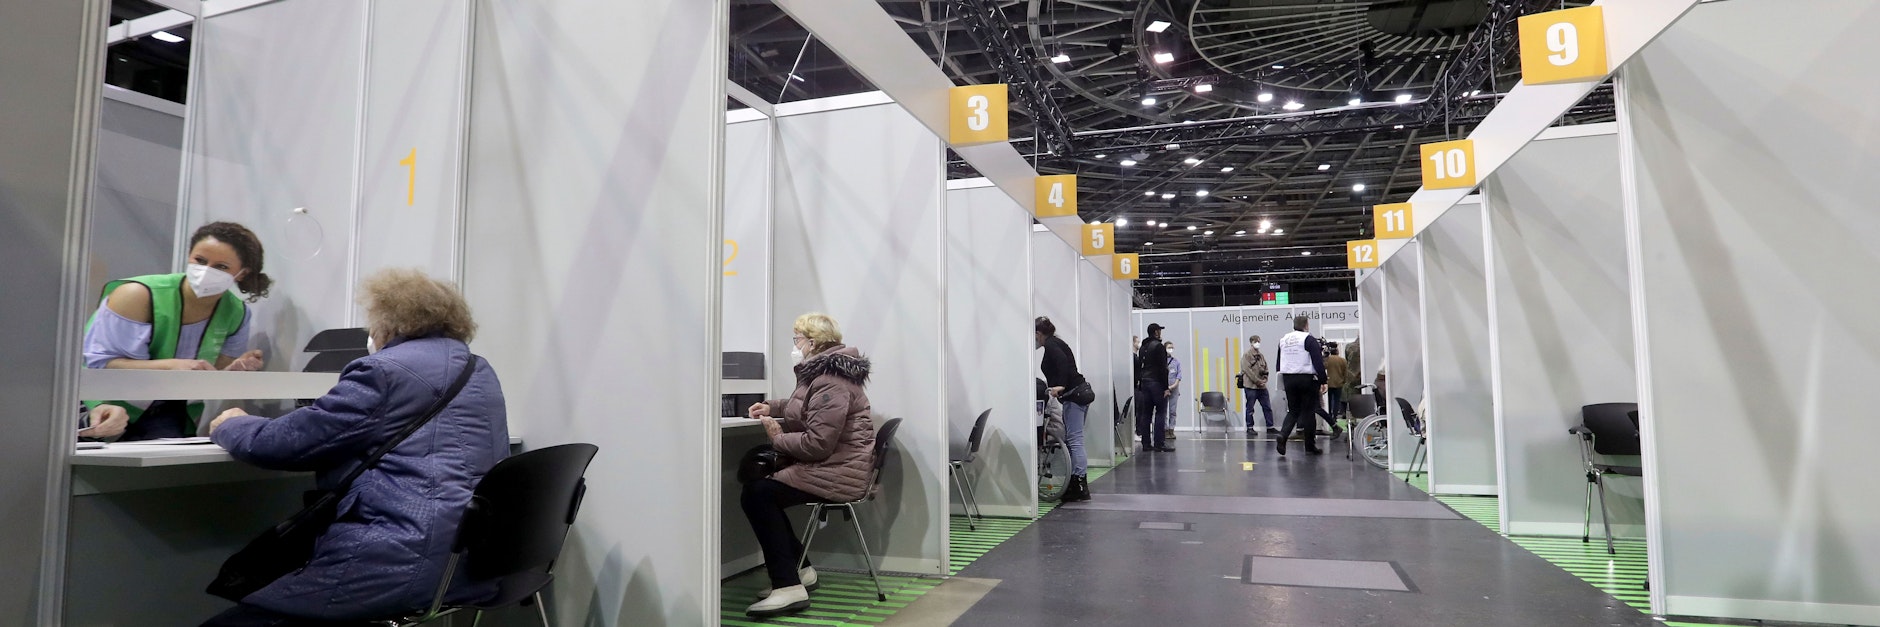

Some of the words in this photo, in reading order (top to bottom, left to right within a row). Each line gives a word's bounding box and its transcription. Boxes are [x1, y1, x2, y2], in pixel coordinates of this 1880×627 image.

[1546, 22, 1579, 66] 9
[967, 95, 989, 131] 3
[400, 148, 416, 205] 1
[1429, 148, 1466, 179] 10
[1048, 182, 1064, 208] 4
[1382, 209, 1406, 232] 11
[1092, 229, 1105, 249] 5
[723, 240, 738, 275] 2
[1352, 244, 1373, 262] 12
[1120, 258, 1131, 275] 6
[1222, 312, 1278, 324] Allgemeine
